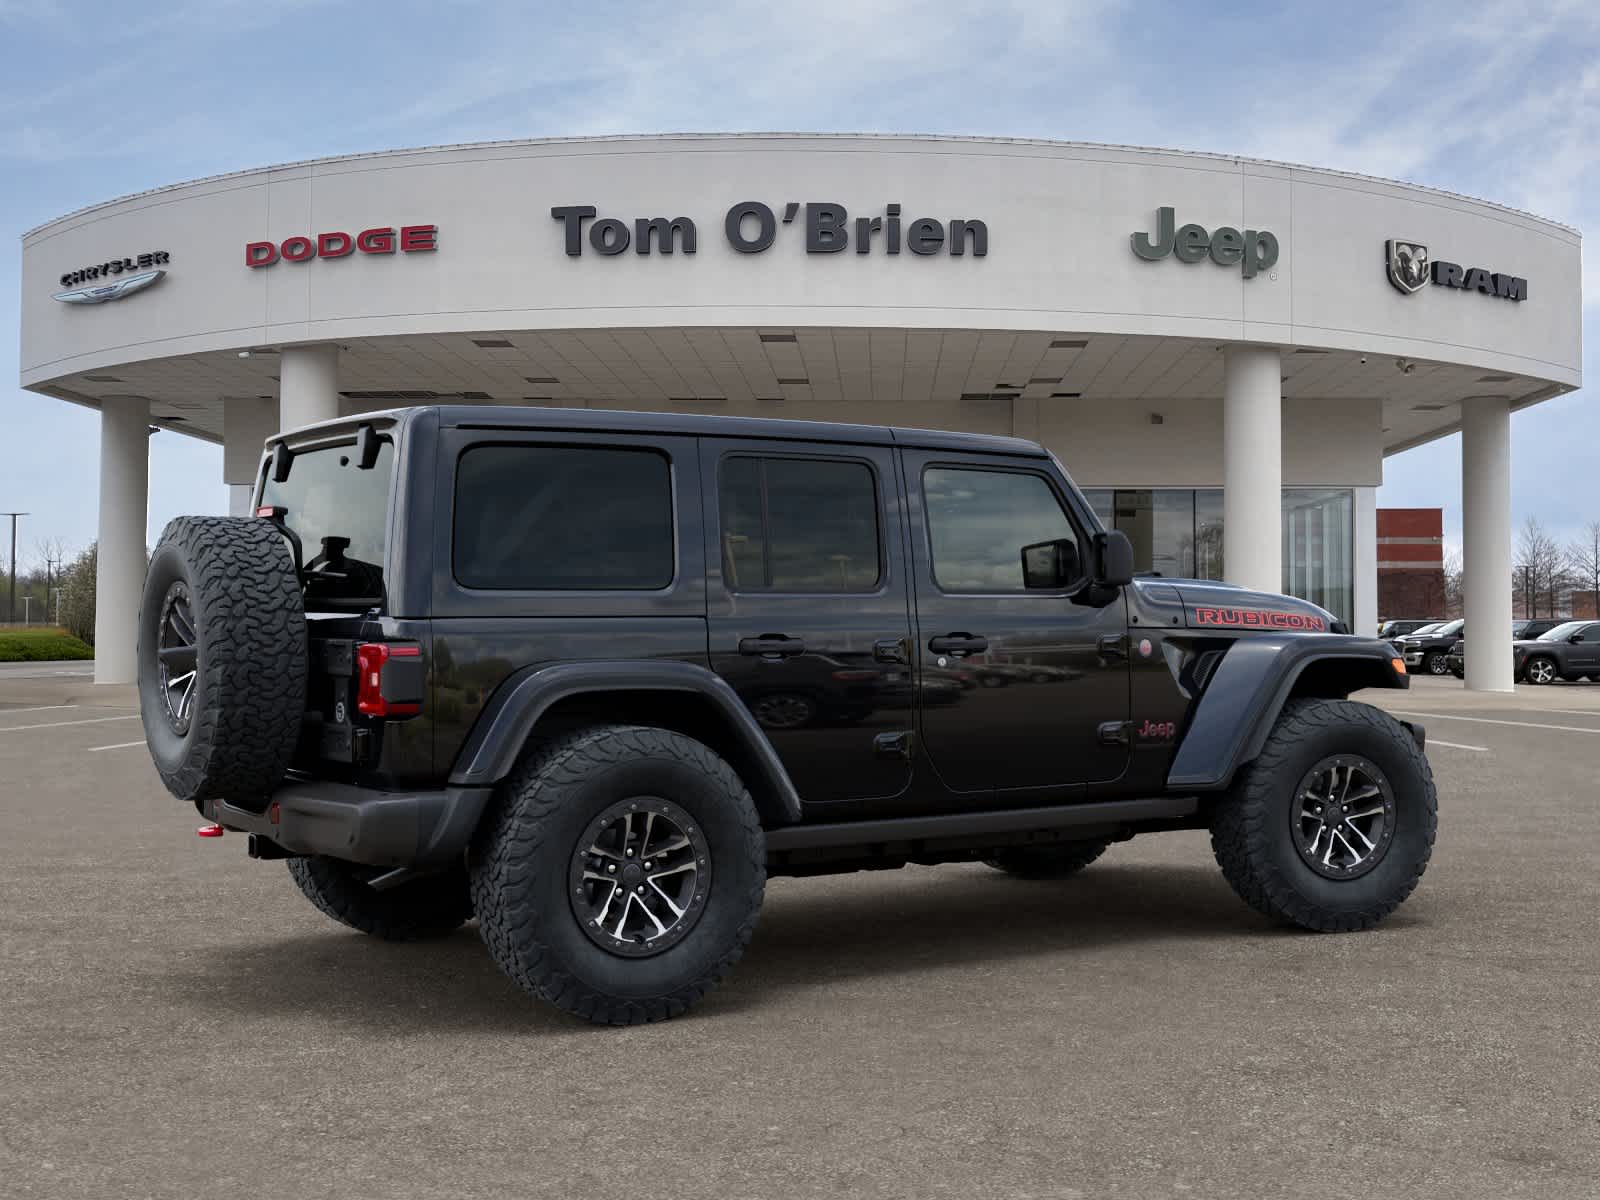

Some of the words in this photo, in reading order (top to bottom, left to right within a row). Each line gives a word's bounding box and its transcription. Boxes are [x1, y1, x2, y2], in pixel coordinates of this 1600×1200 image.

[246, 224, 438, 268] DODGE
[551, 205, 697, 256] Tom
[725, 200, 988, 256] O'Brien
[1130, 206, 1279, 279] Jeep
[60, 250, 170, 287] CHRYSLER
[1431, 260, 1528, 301] RAM
[1196, 607, 1326, 632] RUBICON
[1136, 720, 1176, 738] Jeep
